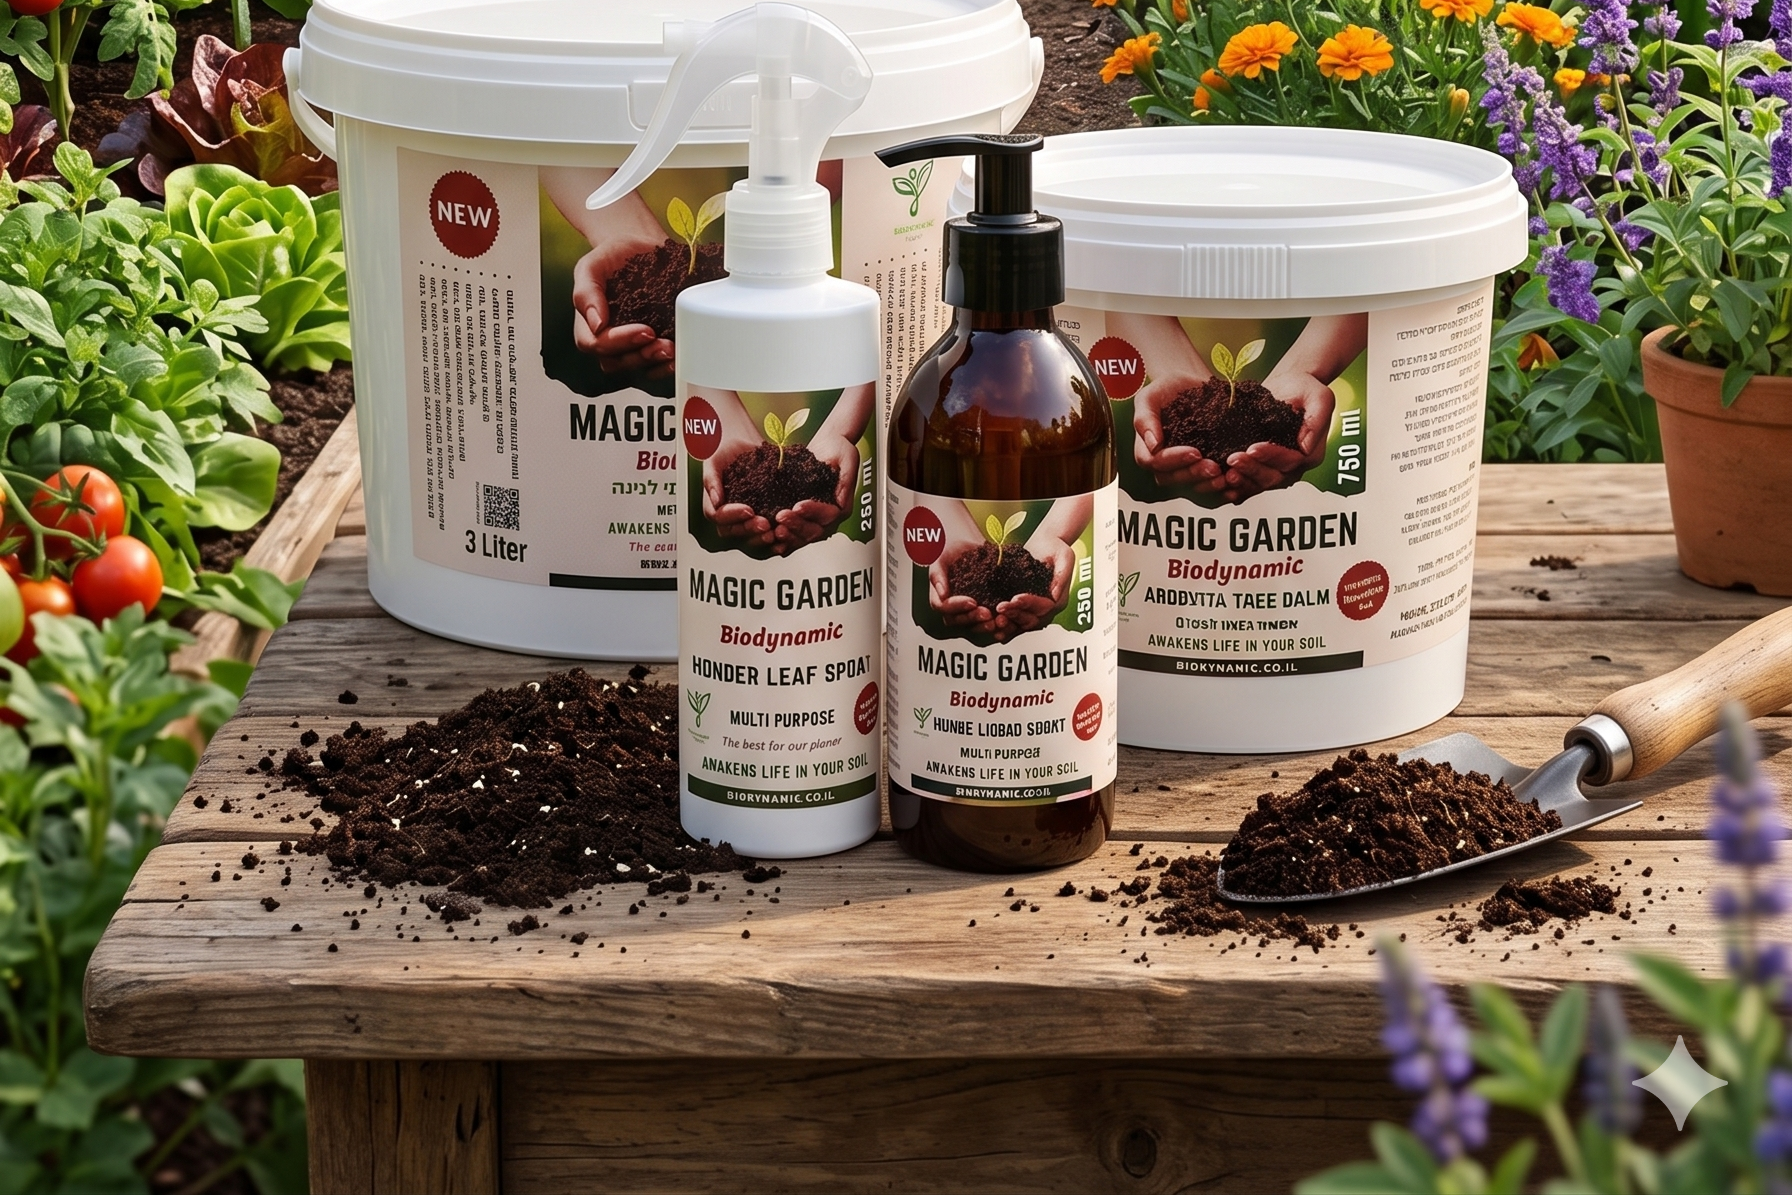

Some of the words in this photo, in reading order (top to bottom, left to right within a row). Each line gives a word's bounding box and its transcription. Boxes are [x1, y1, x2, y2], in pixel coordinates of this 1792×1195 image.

[437, 200, 492, 228] NEW
[1095, 359, 1137, 376] NEW
[570, 403, 676, 442] MAGIC
[685, 418, 717, 435] NEW
[1340, 408, 1361, 437] ml
[1338, 444, 1361, 485] 750
[608, 522, 670, 535] AWAKENS
[906, 528, 942, 543] NEW
[1118, 509, 1217, 551] MAGIC
[1229, 511, 1358, 553] GARDEN
[465, 530, 476, 553] 3
[483, 533, 527, 563] Liter
[629, 541, 650, 552] The
[1079, 556, 1092, 583] ml
[1167, 556, 1304, 586] Biodynamic
[690, 568, 765, 610] MAGIC
[777, 567, 873, 611] GARDEN
[1077, 587, 1092, 626] 250
[720, 622, 843, 653] Biodynamic
[1148, 634, 1209, 651] AWAKENS
[1213, 638, 1240, 652] LIFE
[1245, 639, 1258, 652] IN
[1262, 638, 1295, 651] YOUR
[1299, 636, 1327, 650] SOIL
[767, 666, 818, 686] LEAF
[918, 645, 988, 681] MAGIC
[998, 645, 1088, 682] GARDEN
[950, 689, 1055, 713] Biodynamic
[730, 710, 769, 727] MULTI
[774, 709, 836, 728] PURPOSE
[722, 736, 740, 748] The
[743, 738, 766, 751] best
[768, 740, 785, 751] for
[789, 743, 808, 751] our
[762, 765, 790, 779] LIFE
[796, 765, 808, 779] IN
[813, 759, 844, 776] YOUR
[848, 752, 868, 771] SOIL
[980, 768, 1005, 780] LIFE
[1010, 768, 1020, 780] IN
[1025, 765, 1053, 779] YOUR
